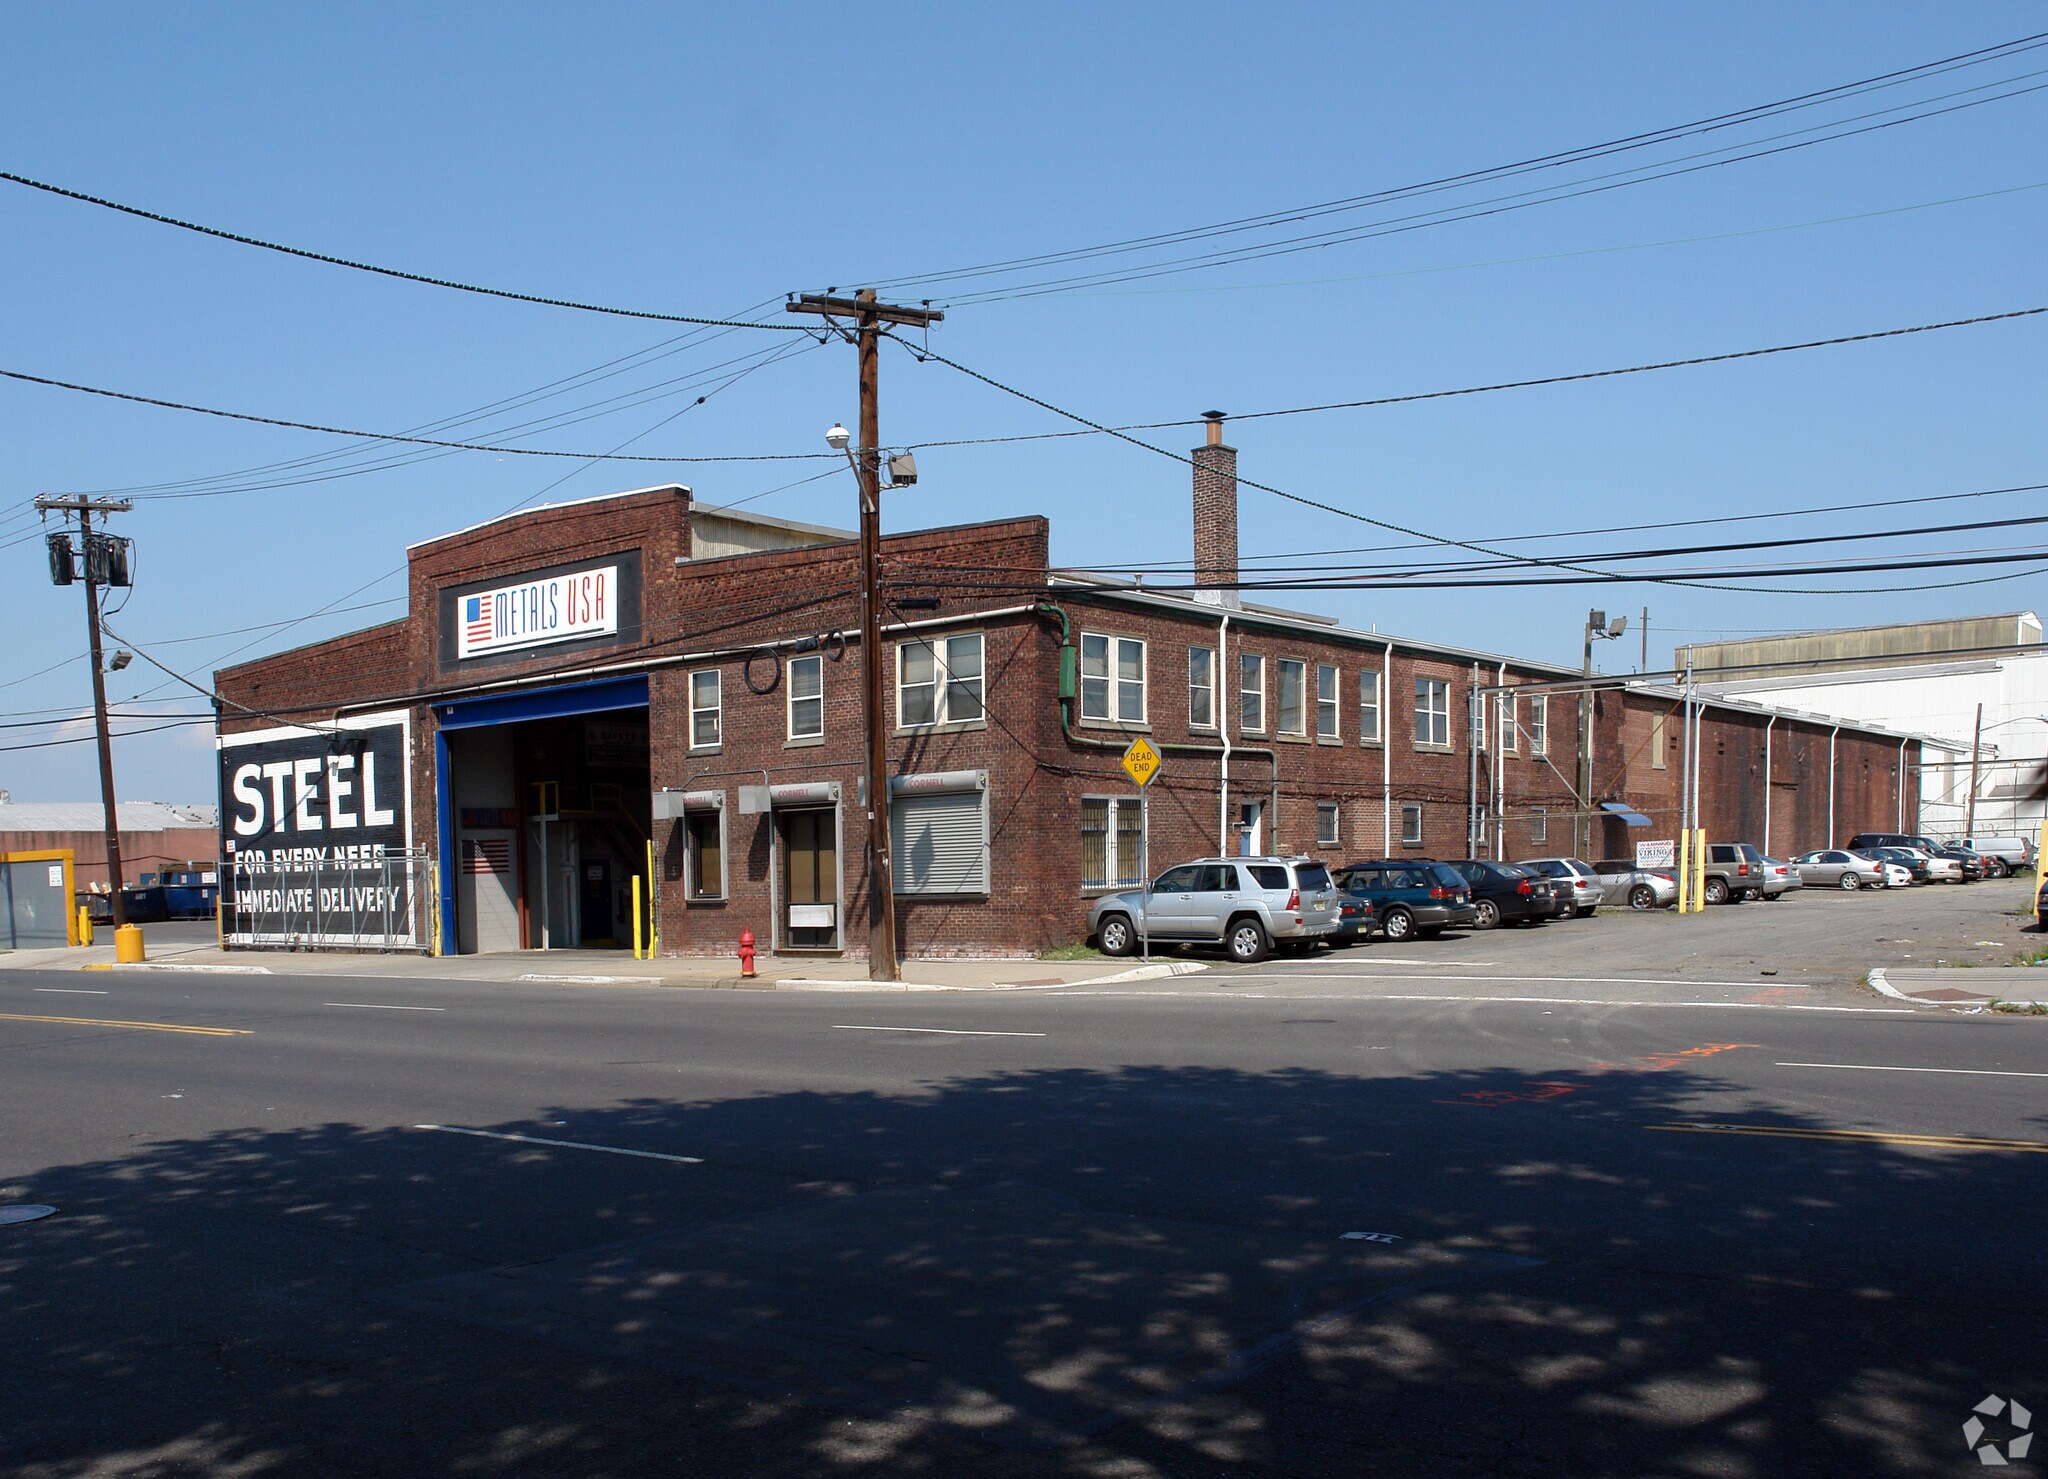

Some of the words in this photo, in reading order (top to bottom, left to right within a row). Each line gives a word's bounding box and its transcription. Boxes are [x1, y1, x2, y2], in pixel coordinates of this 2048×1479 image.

[495, 582, 558, 639] METALS
[568, 573, 604, 625] USA
[1130, 752, 1152, 761] DEAD
[1133, 763, 1150, 772] END
[908, 778, 945, 789] CORNELL
[233, 751, 394, 836] STEEL
[778, 789, 809, 798] CORNELL
[684, 796, 706, 804] ORNELL
[235, 849, 266, 875] FOR
[272, 846, 327, 873] EVERY
[236, 888, 313, 913] IMMEDIATE
[320, 886, 400, 912] DELIVERY
